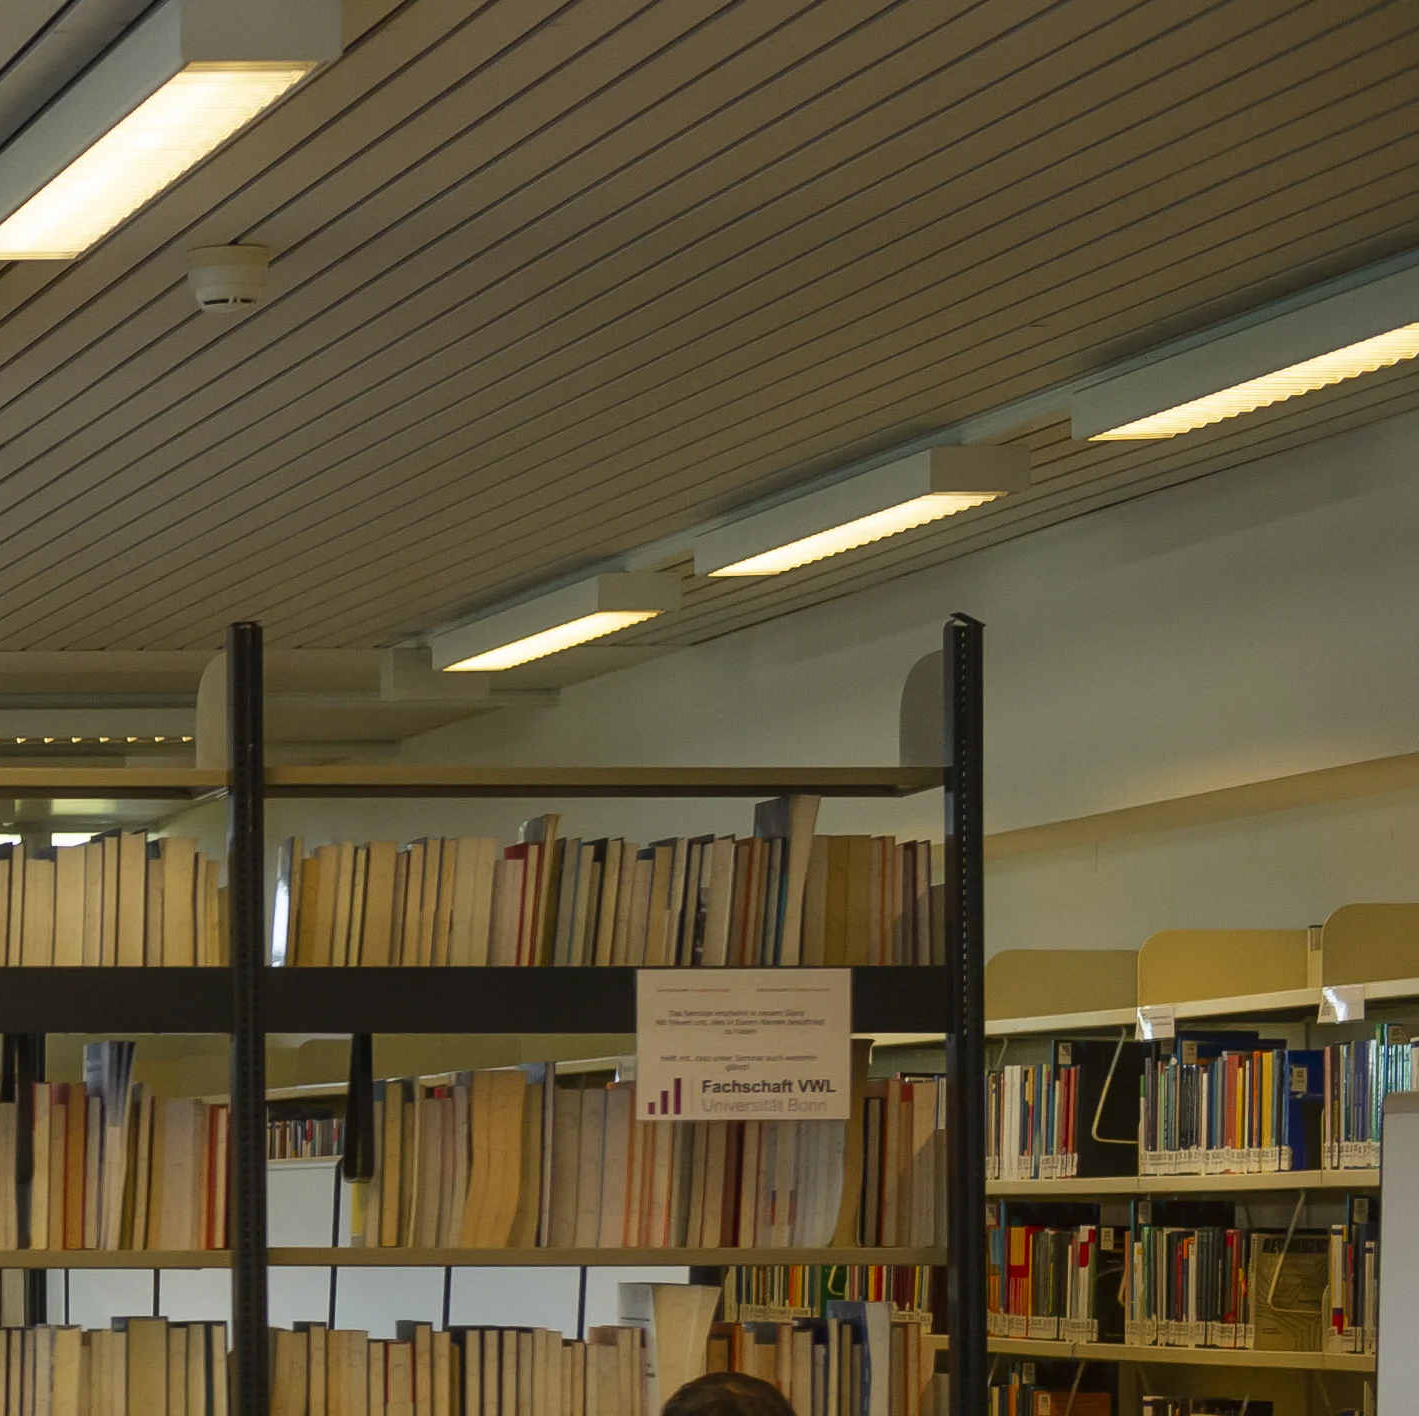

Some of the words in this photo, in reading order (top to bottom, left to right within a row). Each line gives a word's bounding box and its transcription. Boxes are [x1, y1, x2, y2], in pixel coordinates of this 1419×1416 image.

[702, 1079, 793, 1094] Fachschaft
[798, 1079, 836, 1094] VWL
[702, 1098, 784, 1113] Universität
[788, 1098, 827, 1113] Bonn
